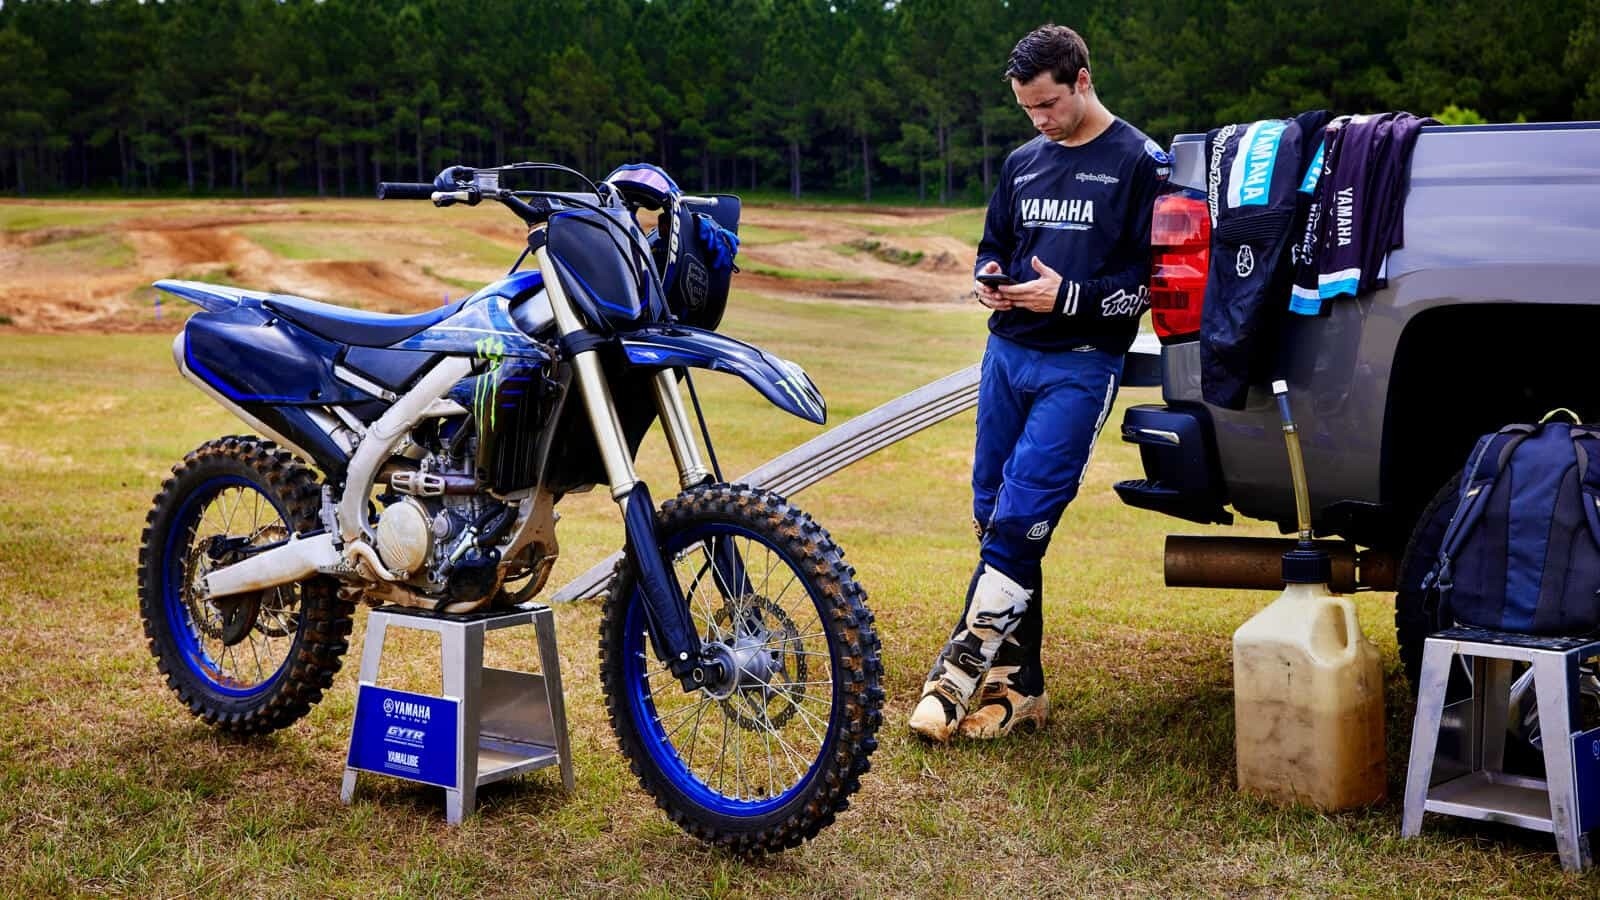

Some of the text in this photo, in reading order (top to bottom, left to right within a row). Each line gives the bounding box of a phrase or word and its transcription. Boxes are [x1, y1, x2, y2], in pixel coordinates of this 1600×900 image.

[1244, 125, 1282, 200] YAMAHA
[1021, 199, 1094, 223] YAMAHA
[1337, 187, 1353, 247] YAMAHA
[394, 700, 431, 720] YAMAHA
[387, 725, 425, 740] GYTR
[387, 750, 419, 767] YAMALUBE
